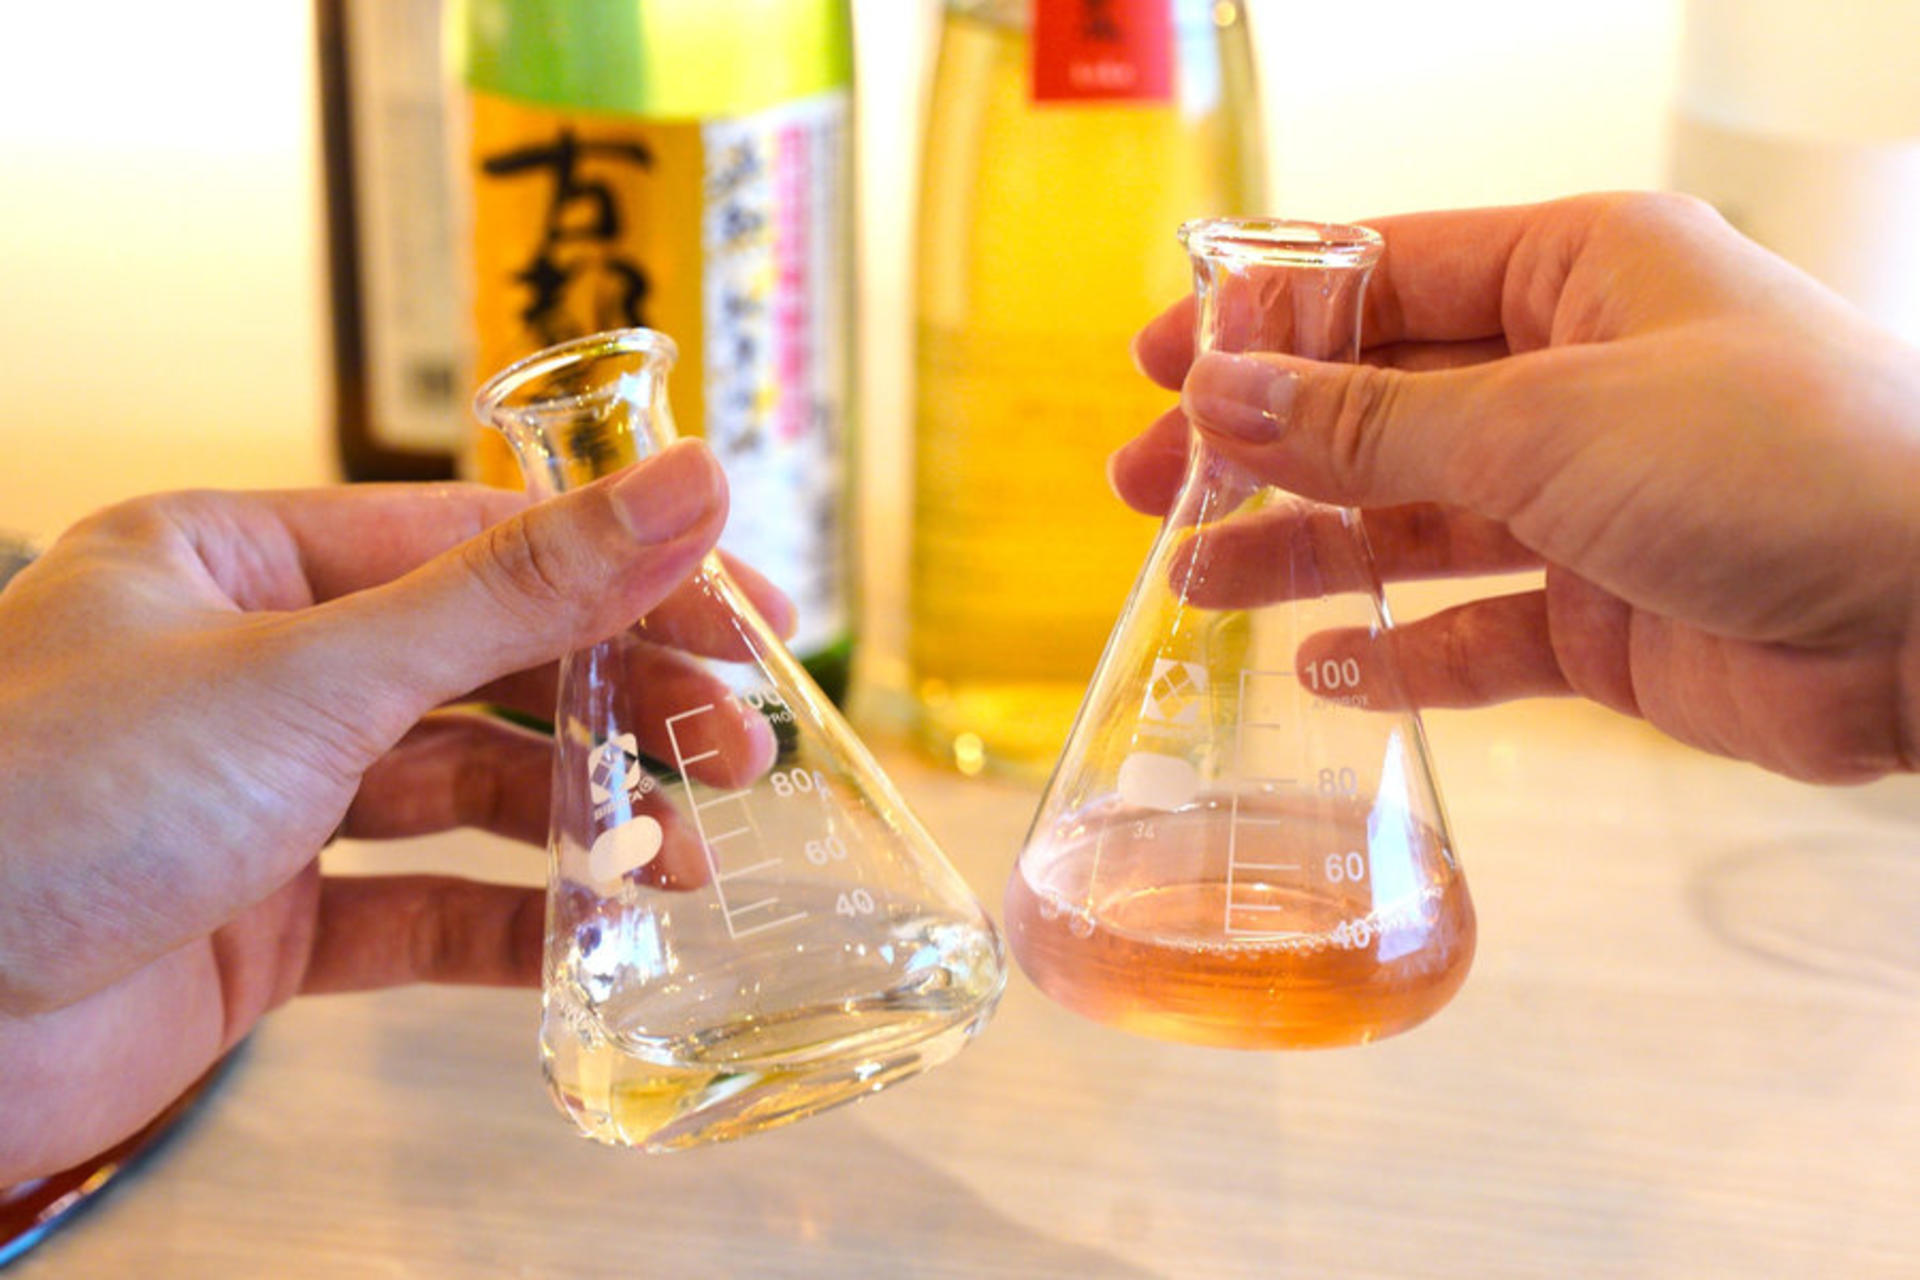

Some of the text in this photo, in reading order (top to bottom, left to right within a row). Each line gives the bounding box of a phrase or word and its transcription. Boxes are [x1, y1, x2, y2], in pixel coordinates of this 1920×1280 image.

[1304, 658, 1360, 691] 100
[724, 683, 782, 713] 100
[770, 767, 812, 797] 80
[1318, 767, 1358, 797] 80
[805, 835, 847, 866] 60
[1325, 852, 1365, 883] 60
[836, 888, 875, 918] 40
[1331, 918, 1371, 949] 40
